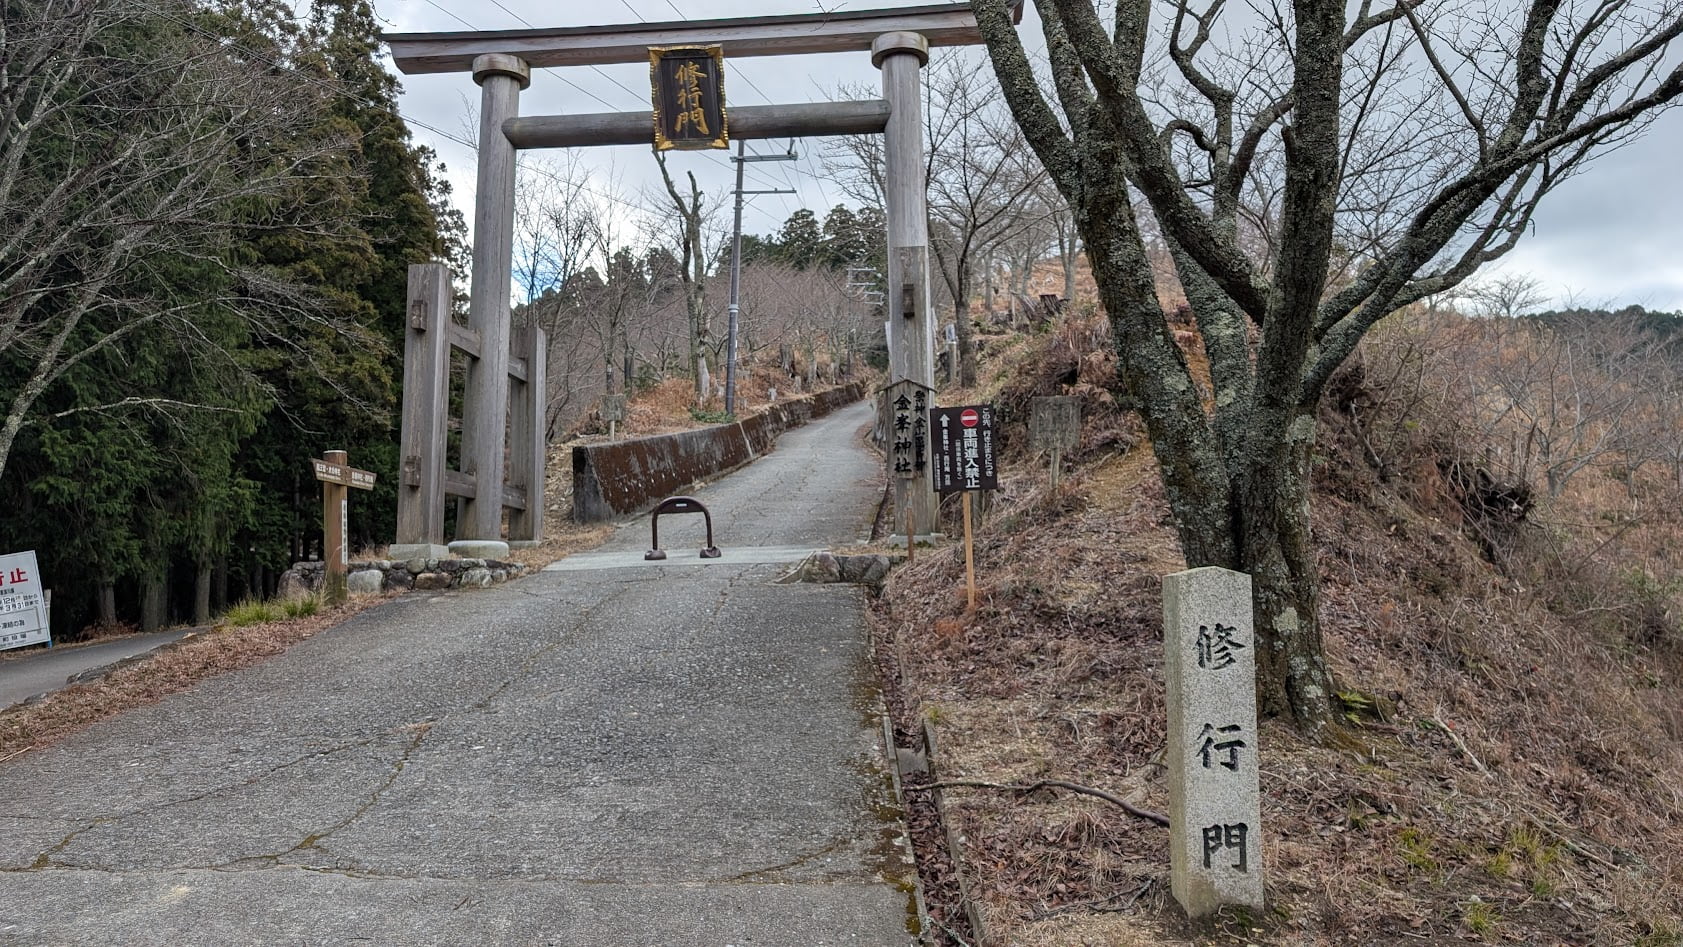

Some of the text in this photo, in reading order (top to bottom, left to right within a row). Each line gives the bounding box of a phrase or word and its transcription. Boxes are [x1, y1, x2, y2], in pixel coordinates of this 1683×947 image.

[674, 61, 710, 135] 修行門
[893, 393, 912, 473] 金峯神社
[963, 428, 981, 488] 車両進入禁止
[0, 568, 28, 587] 止
[1195, 622, 1247, 874] 修行門
